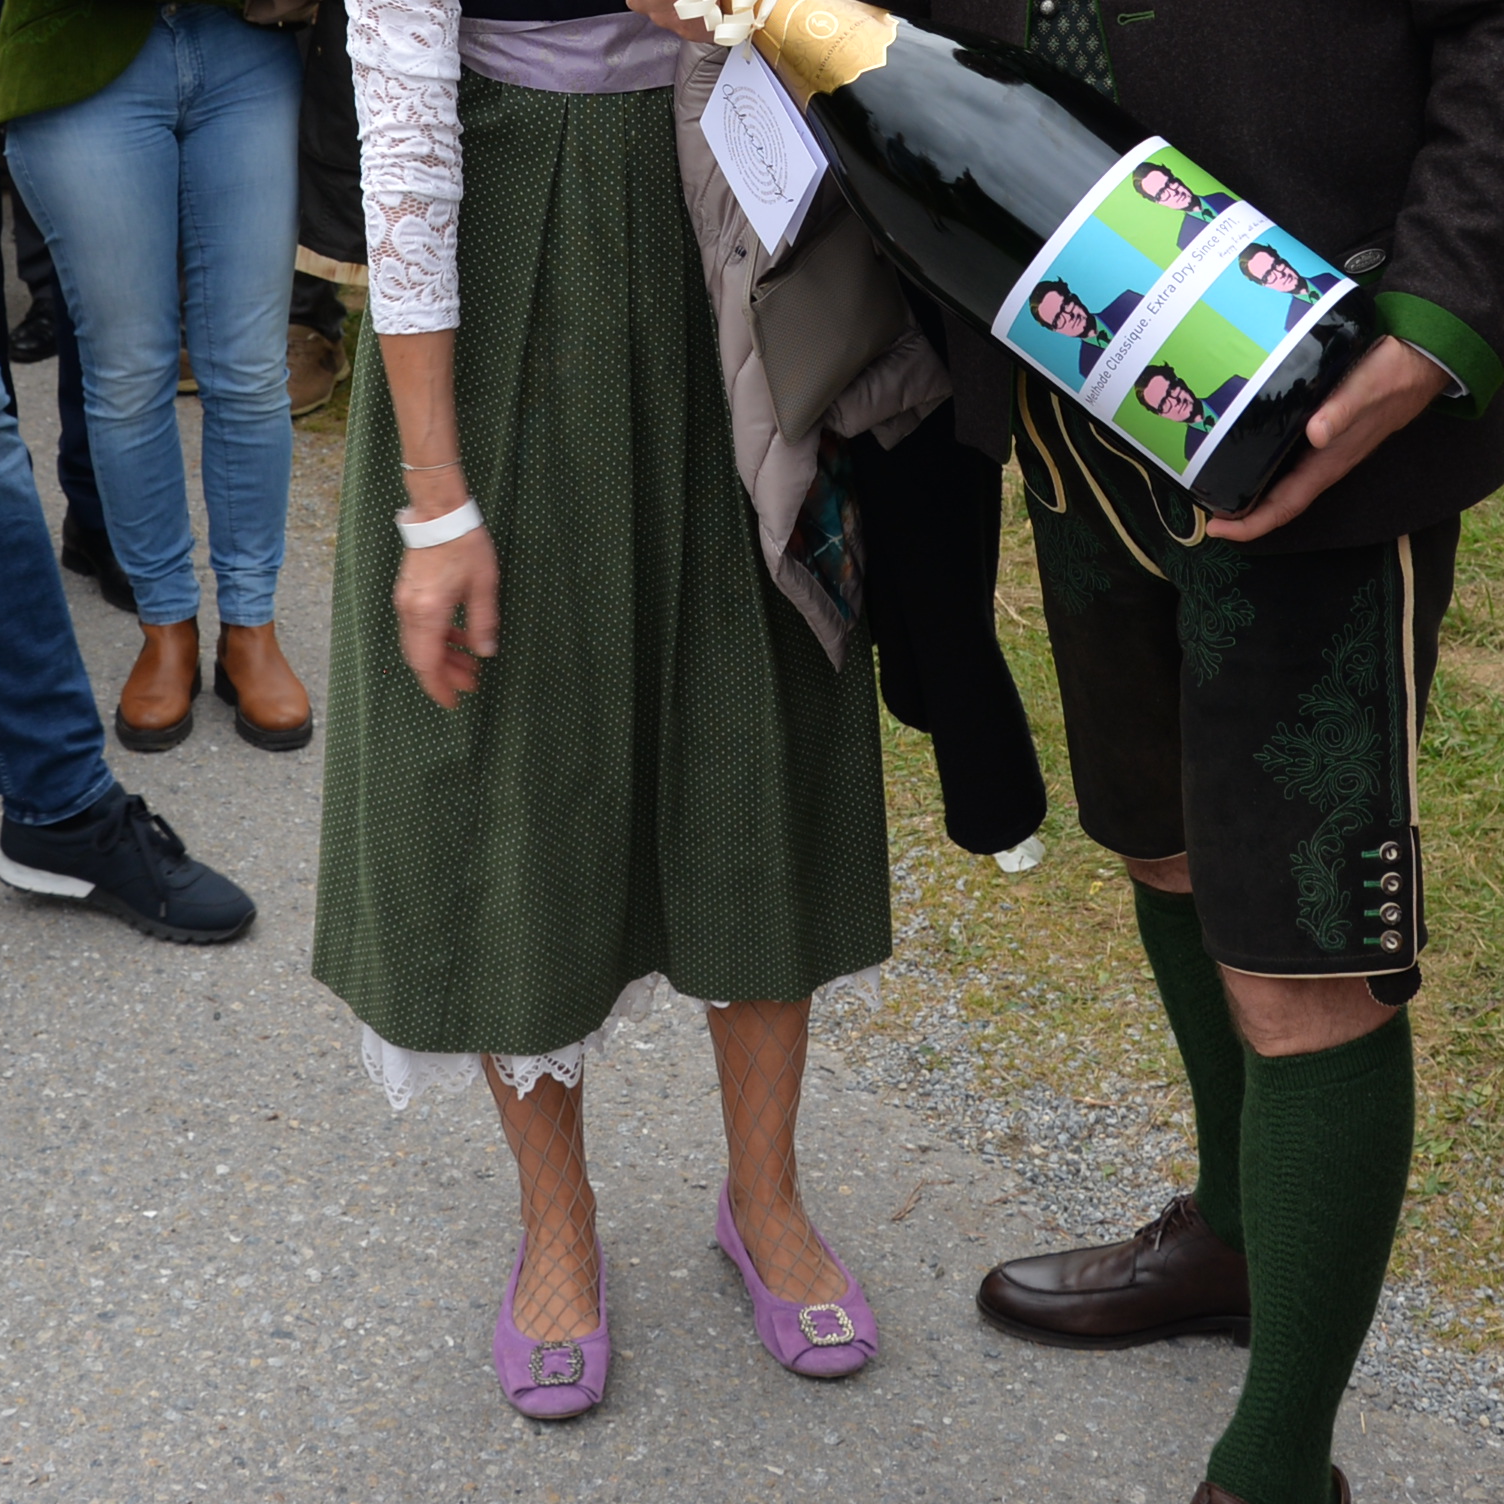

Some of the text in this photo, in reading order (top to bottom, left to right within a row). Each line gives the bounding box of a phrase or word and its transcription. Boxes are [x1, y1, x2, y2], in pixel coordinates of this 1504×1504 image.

[1085, 217, 1240, 406] Methode Classique. Extra Dry. Since 1971.
